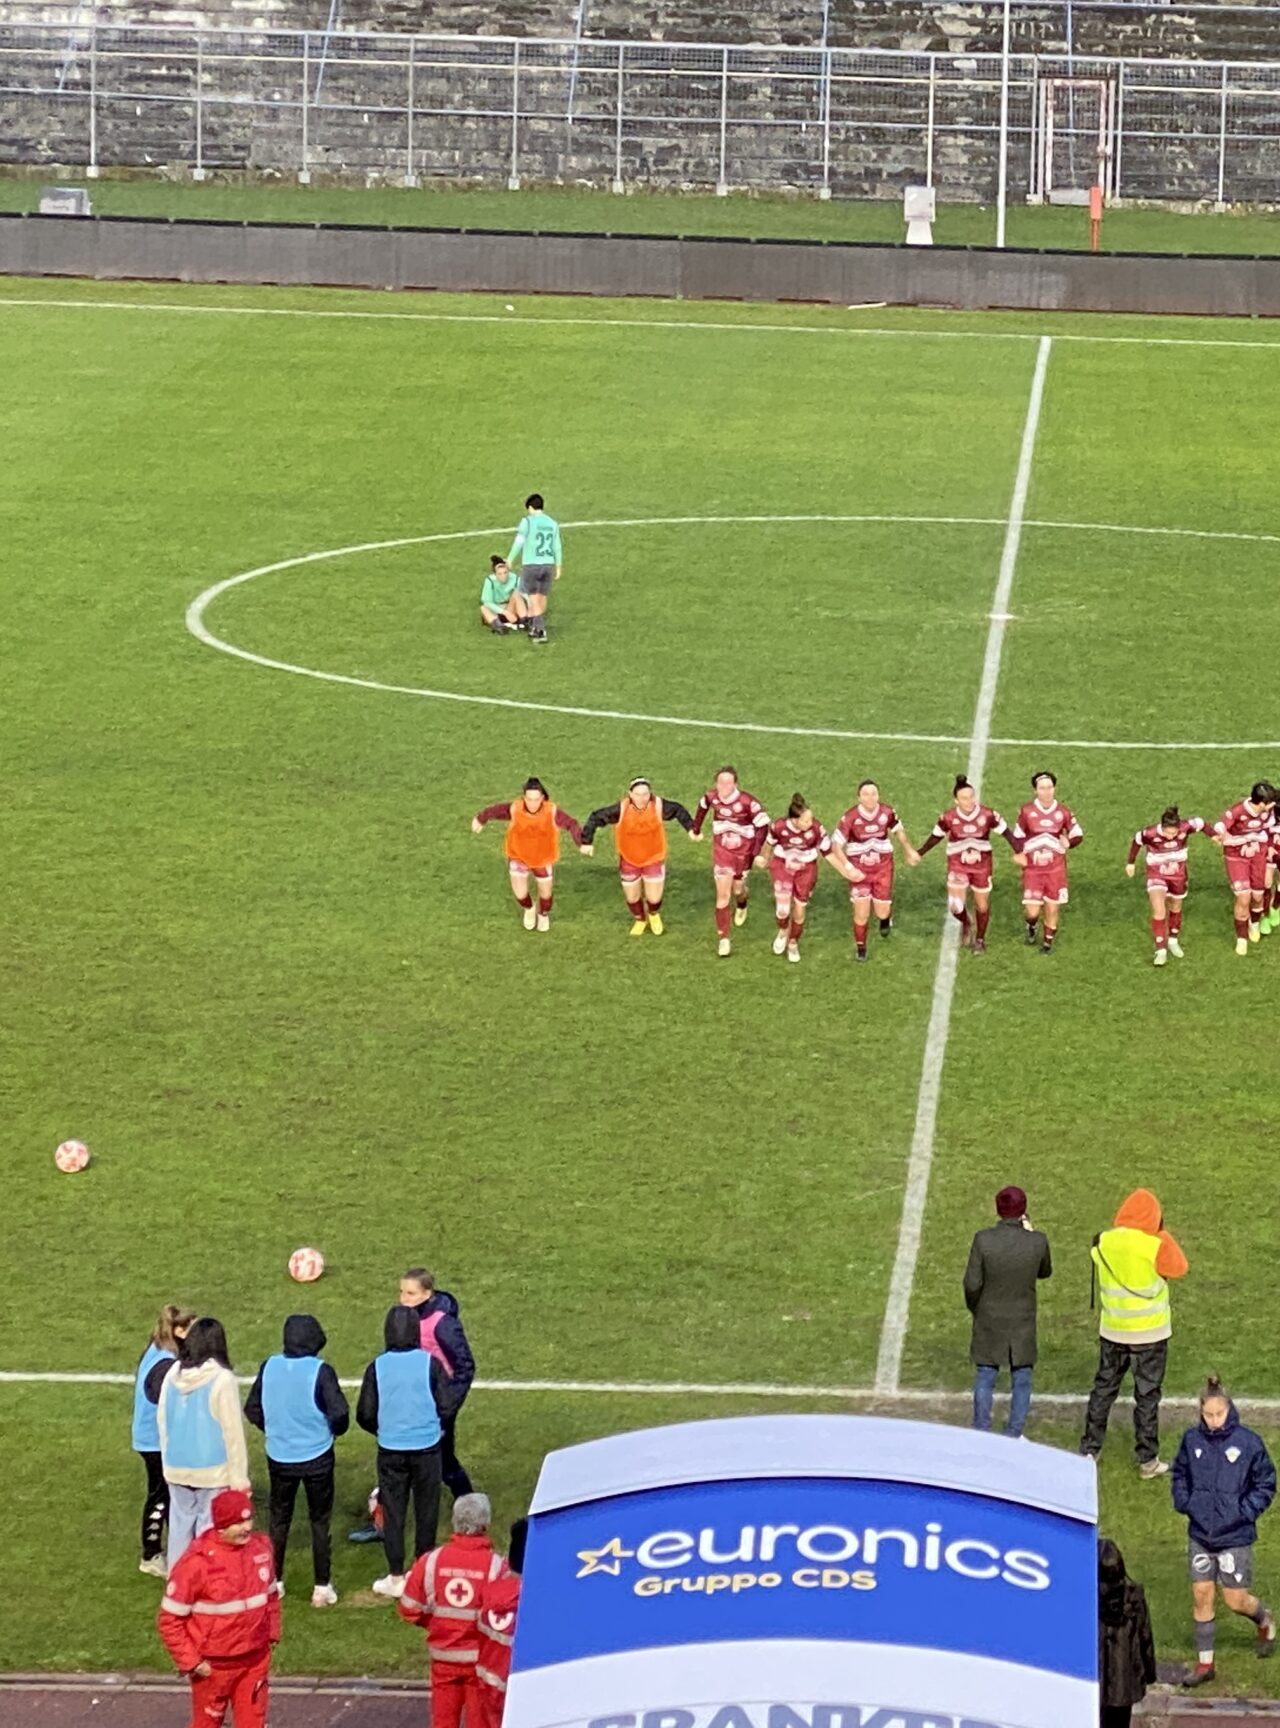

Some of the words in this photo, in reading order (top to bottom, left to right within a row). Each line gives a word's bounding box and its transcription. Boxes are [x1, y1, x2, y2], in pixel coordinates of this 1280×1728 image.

[535, 532, 554, 557] 23
[636, 1522, 1051, 1590] euronics
[633, 1572, 782, 1597] Gruppo
[791, 1567, 878, 1591] CDS
